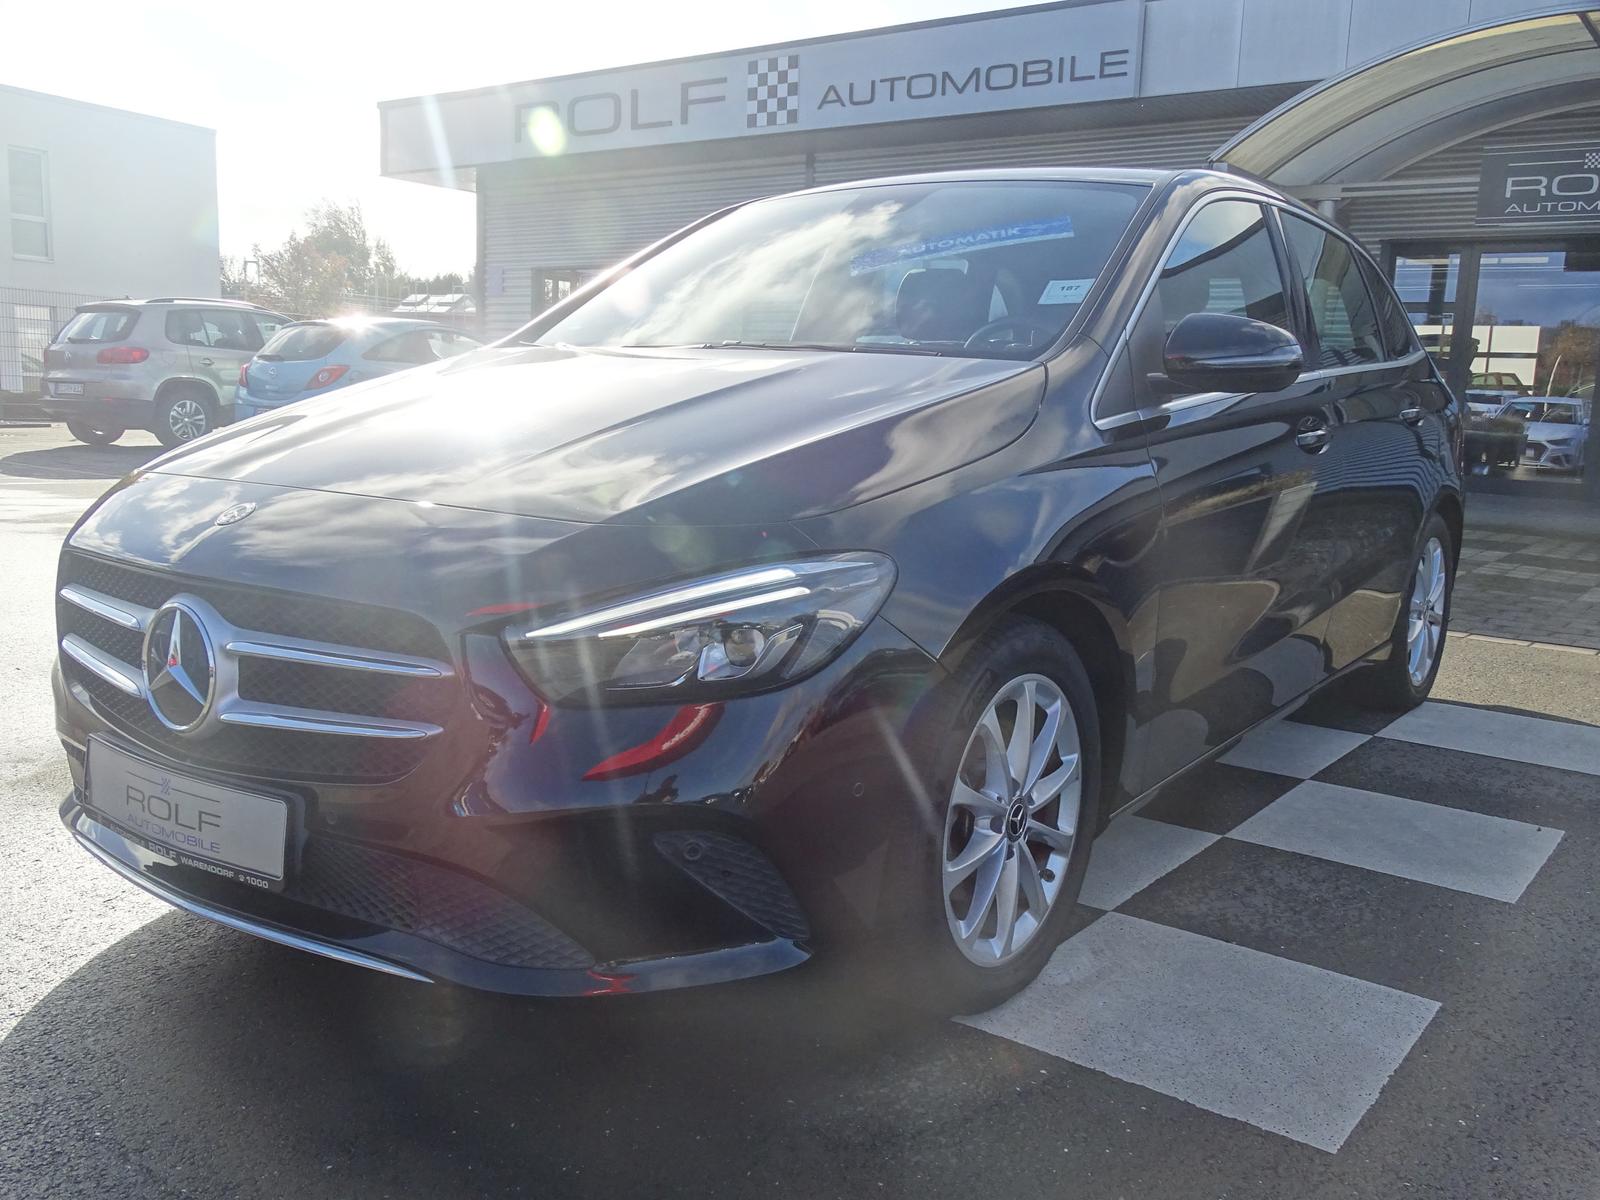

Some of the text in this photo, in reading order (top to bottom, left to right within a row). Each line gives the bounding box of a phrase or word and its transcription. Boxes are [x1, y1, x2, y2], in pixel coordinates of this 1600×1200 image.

[817, 49, 1129, 109] AUTOMOBILE
[1505, 174, 1599, 198] RO
[897, 227, 1021, 255] AUTOMATIK
[126, 785, 221, 832] ROLF
[127, 813, 221, 853] AUTOMOBILE
[148, 843, 269, 889] ROLF WARENDORF 1000
